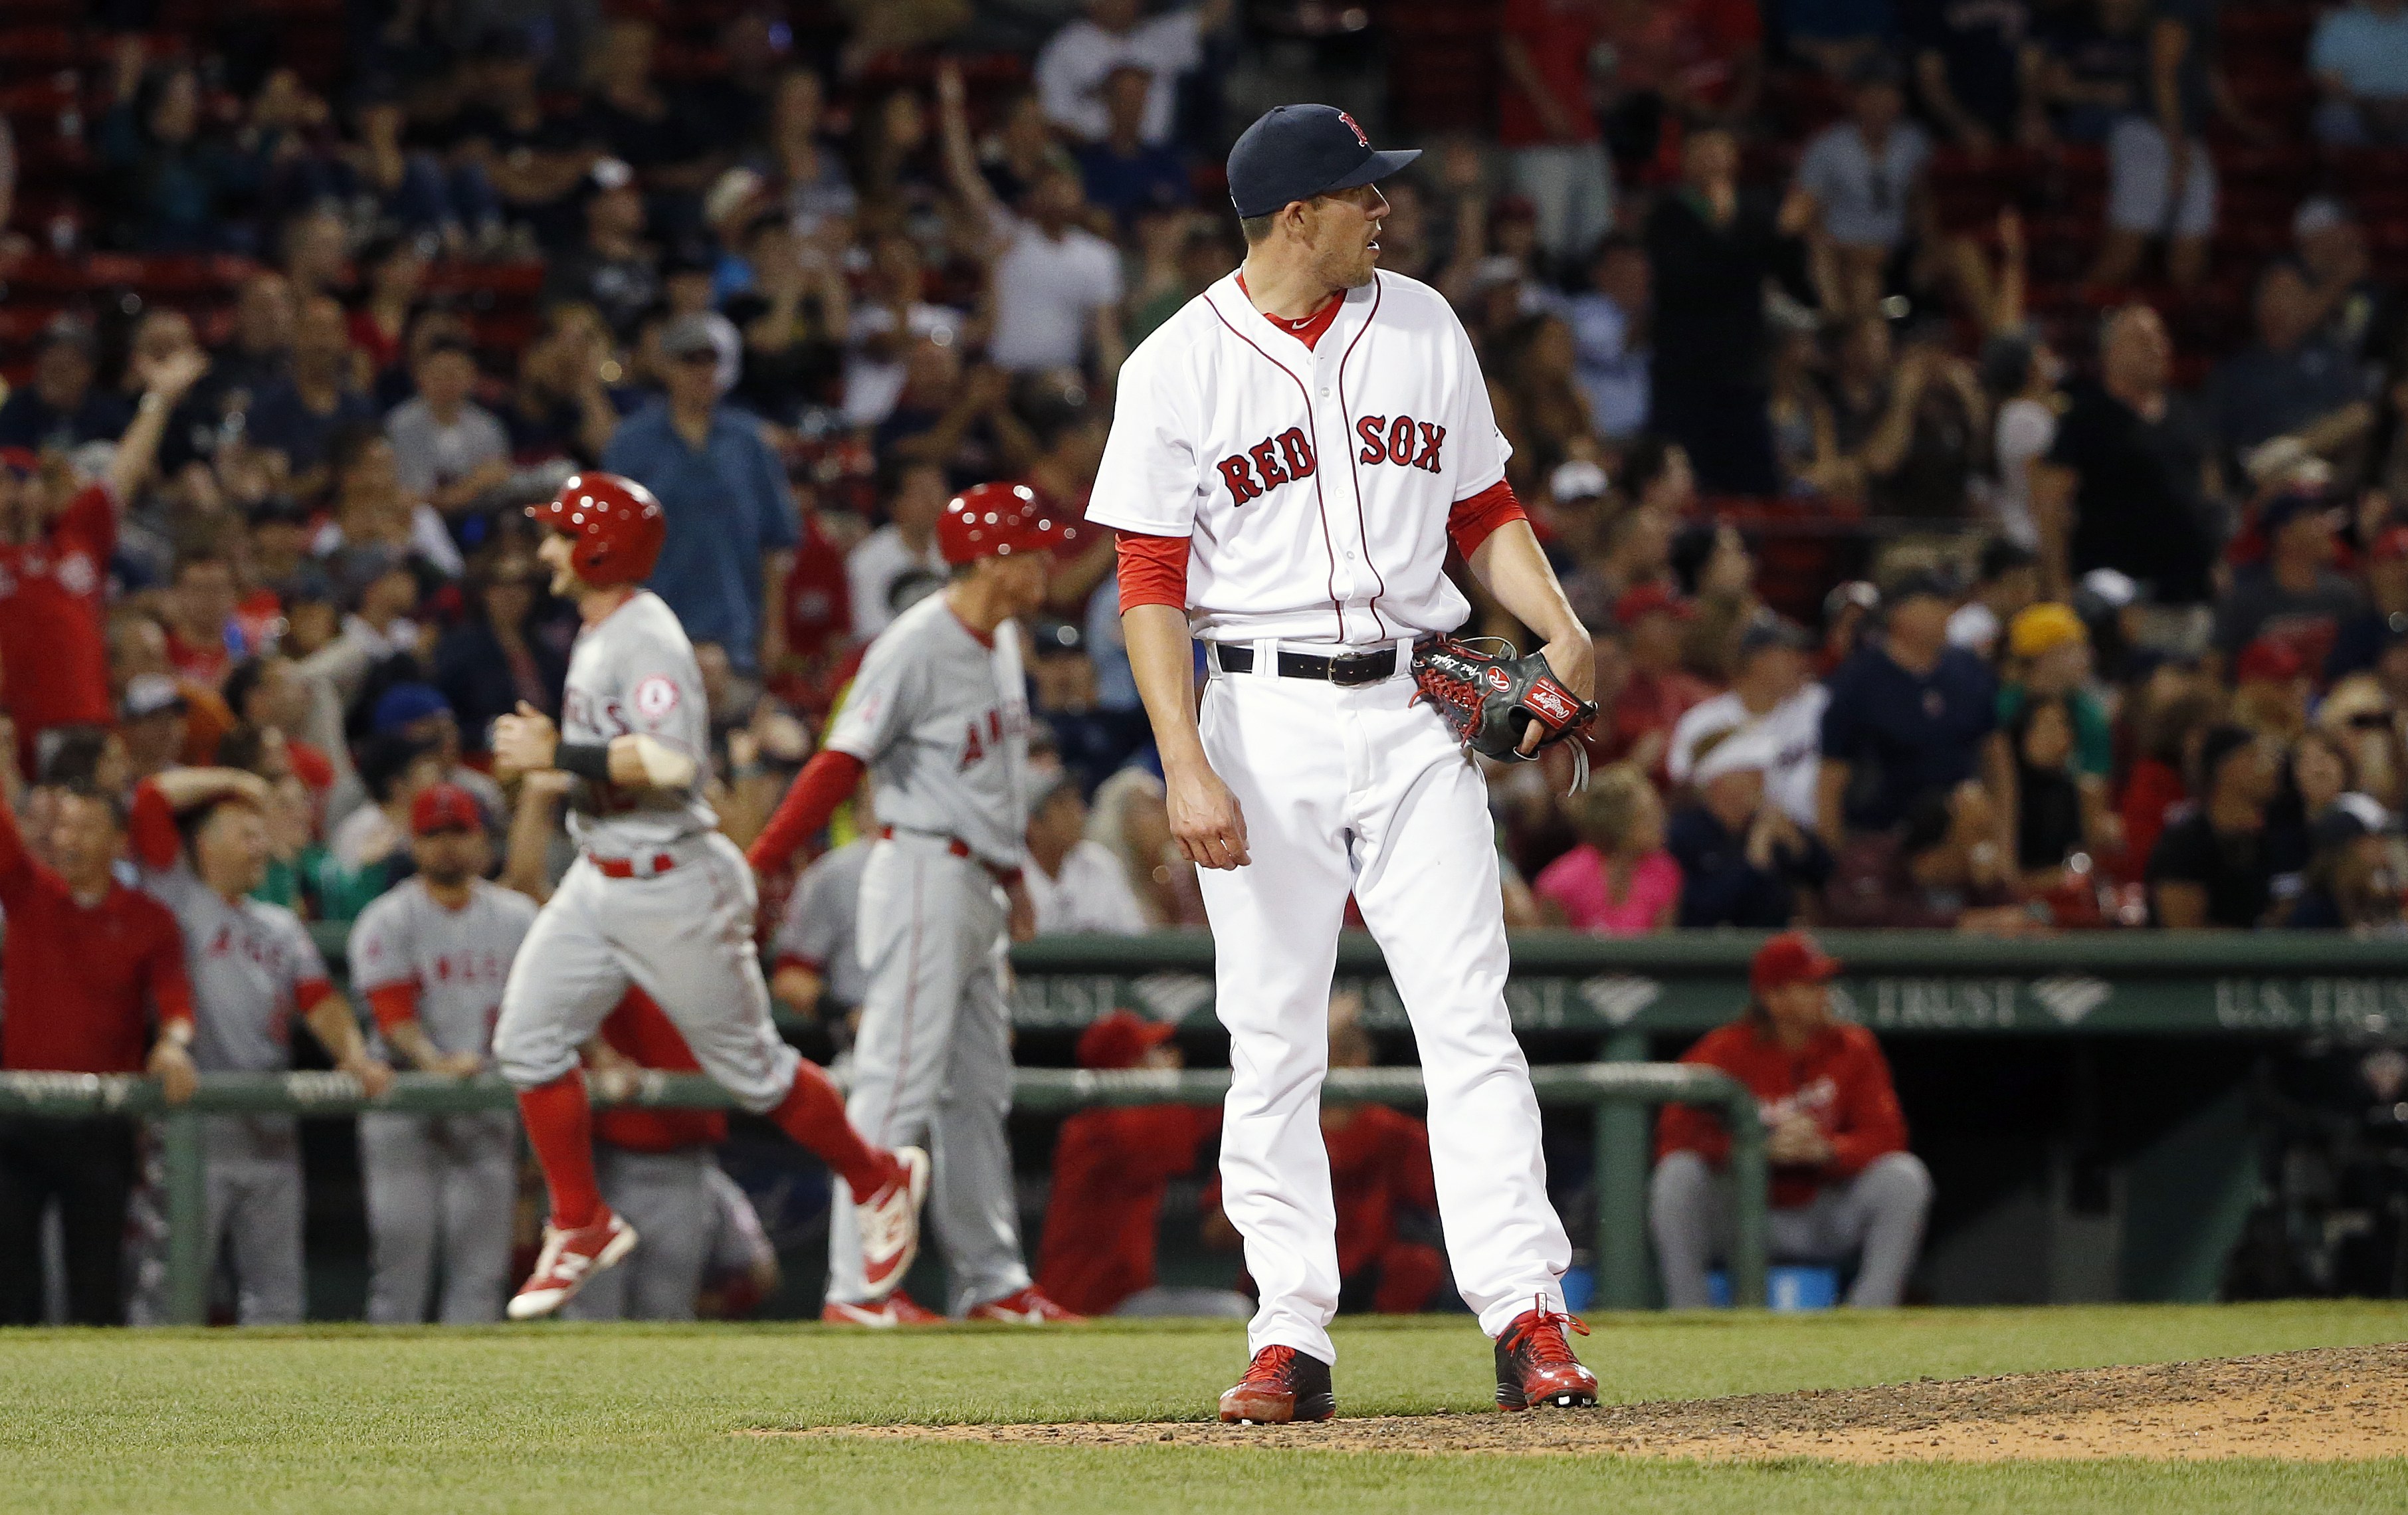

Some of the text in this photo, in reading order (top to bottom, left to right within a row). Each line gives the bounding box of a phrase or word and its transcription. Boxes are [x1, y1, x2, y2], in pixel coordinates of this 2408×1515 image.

[1217, 414, 1447, 508] RED SOX
[1431, 654, 1460, 670] Light
[1532, 692, 1570, 719] Rawlings
[1870, 977, 2021, 1028] TRUST
